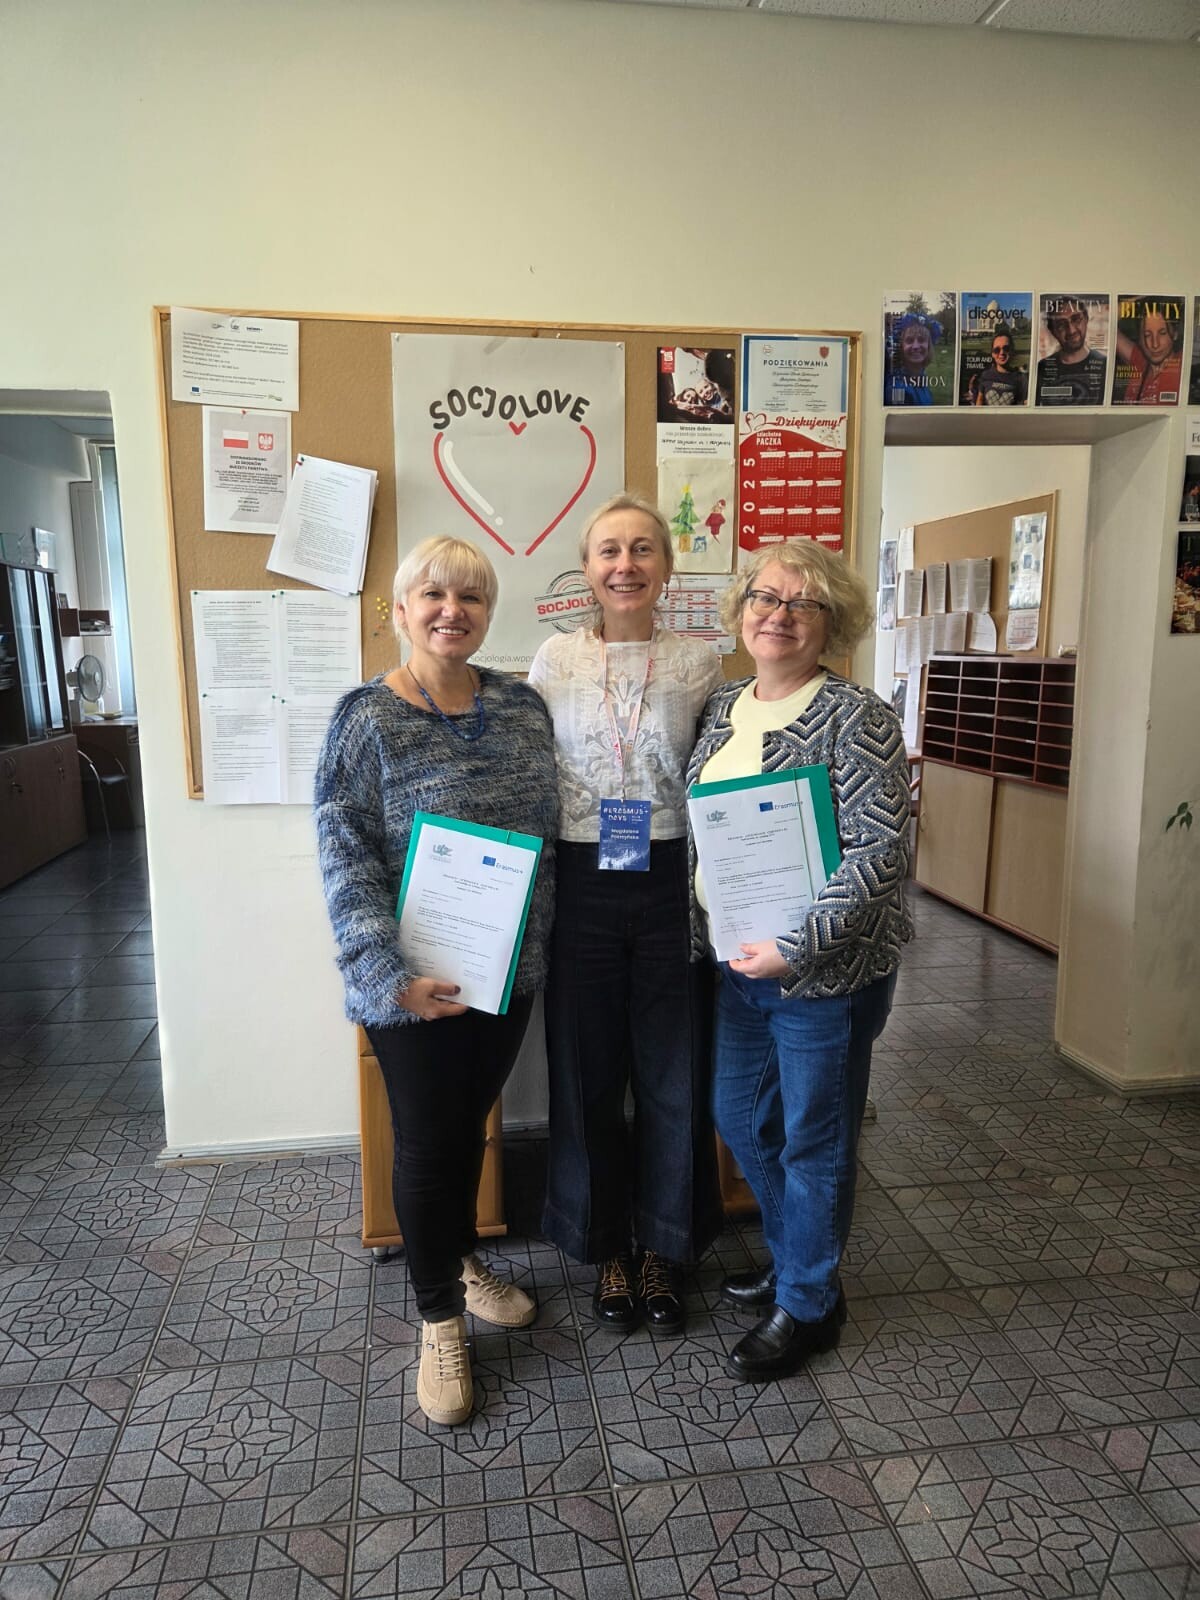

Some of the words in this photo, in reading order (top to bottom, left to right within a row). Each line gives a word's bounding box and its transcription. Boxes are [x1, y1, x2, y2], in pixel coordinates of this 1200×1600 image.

[968, 306, 1026, 319] discover
[1045, 299, 1103, 313] BEAUTY
[1120, 301, 1181, 320] BEAUTY
[763, 359, 829, 367] PODZIĘKOWANIA
[892, 375, 947, 388] FASHION
[429, 385, 591, 430] SOCJOLOVE
[775, 415, 847, 430] Dziękujemy!
[756, 437, 782, 446] PACZKA
